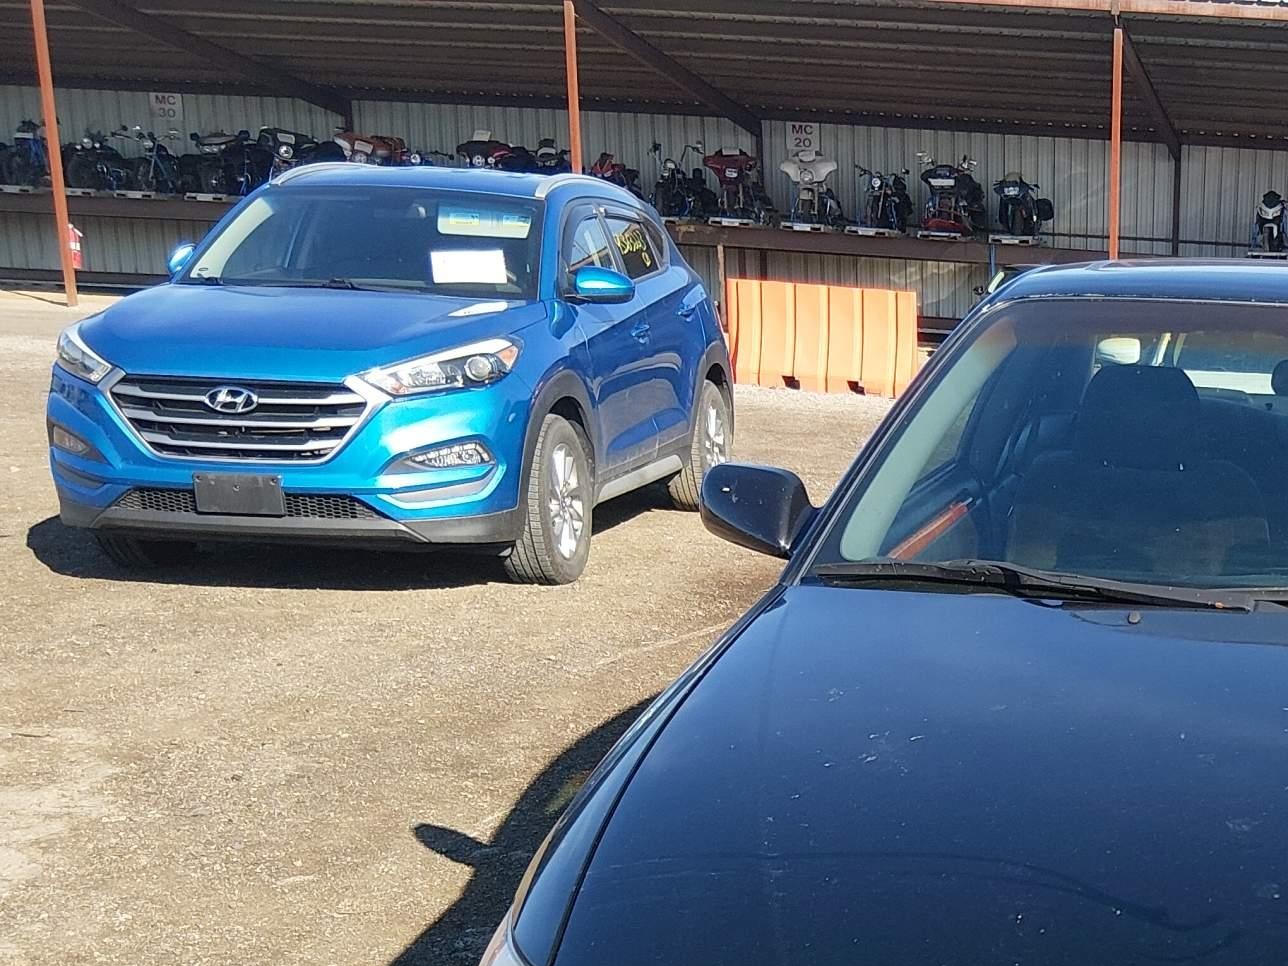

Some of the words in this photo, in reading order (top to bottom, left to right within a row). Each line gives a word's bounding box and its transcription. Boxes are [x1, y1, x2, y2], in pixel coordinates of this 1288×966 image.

[155, 95, 176, 105] MC
[159, 108, 176, 118] 30
[791, 124, 813, 135] MC
[794, 137, 812, 148] 20
